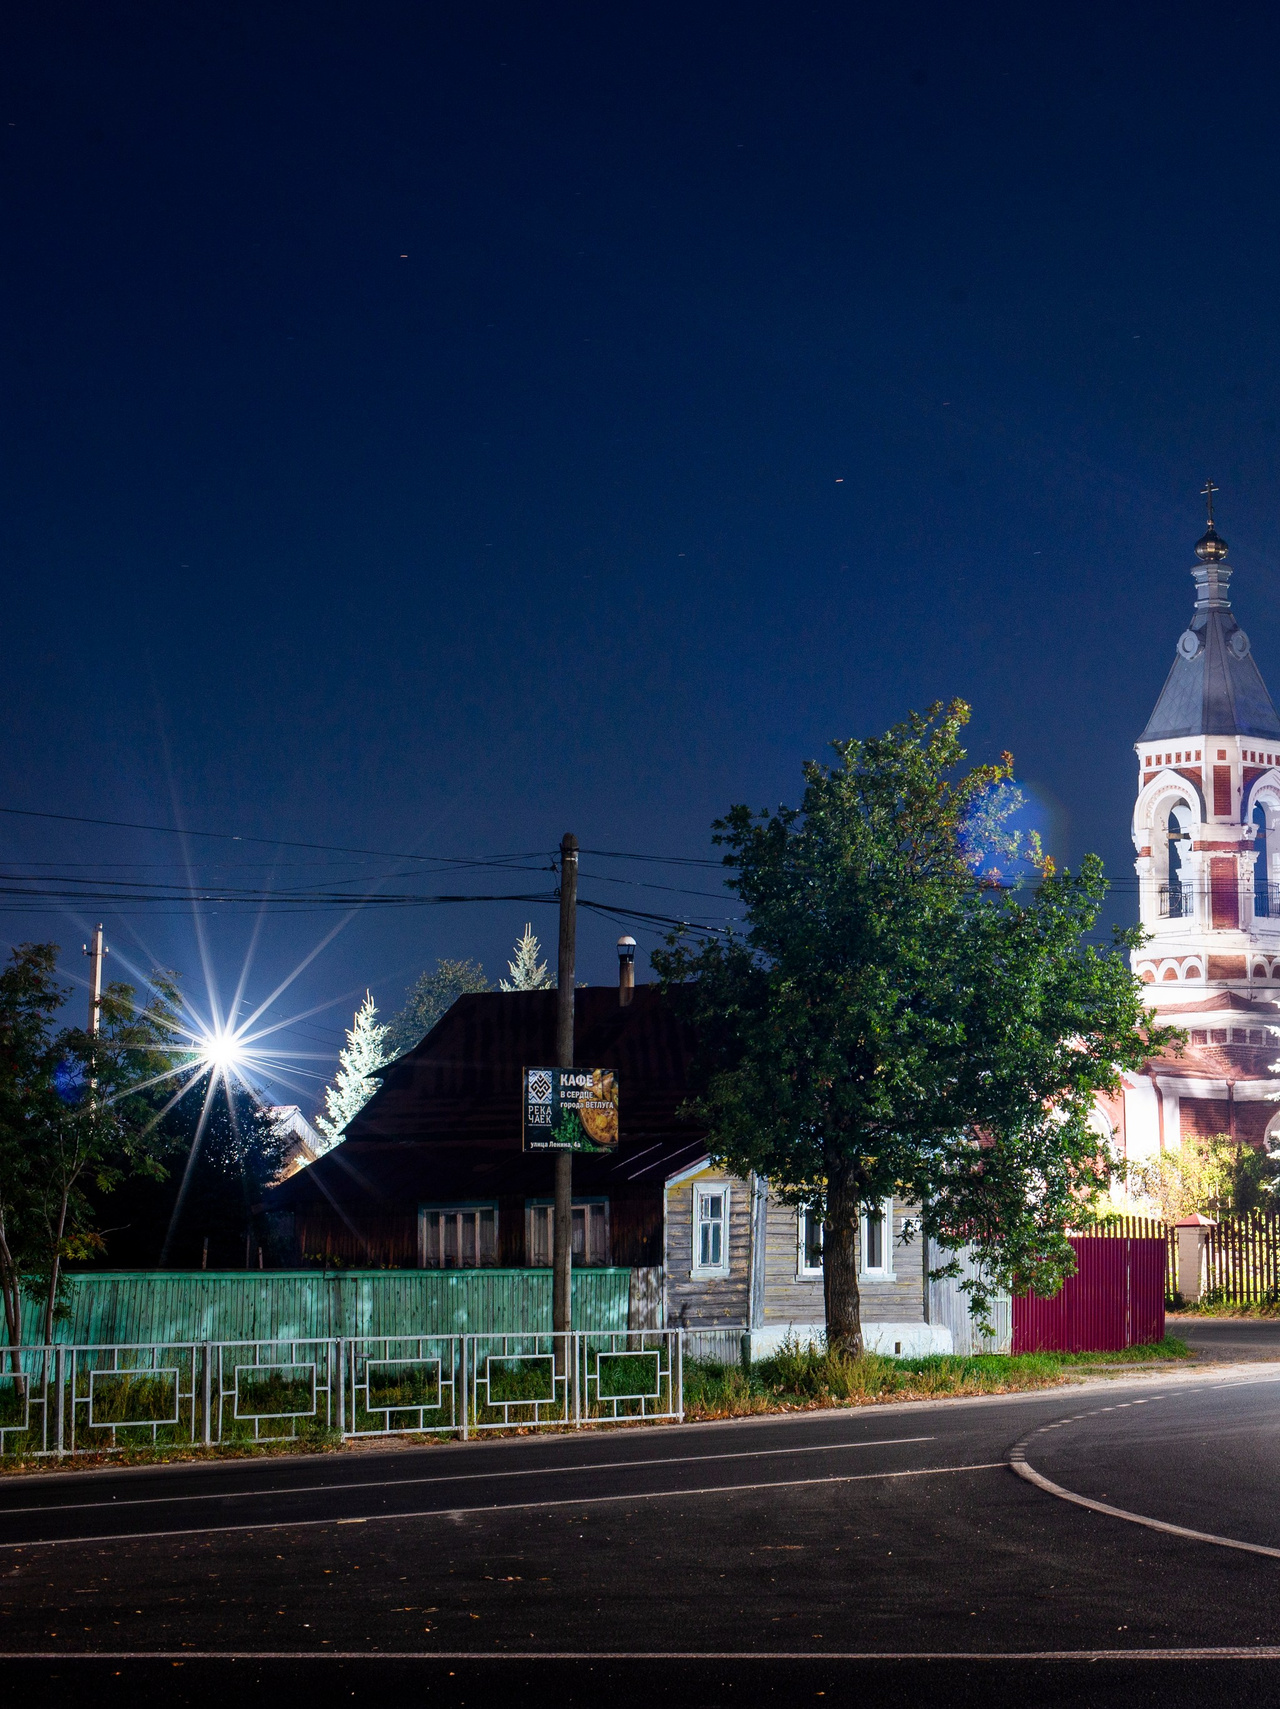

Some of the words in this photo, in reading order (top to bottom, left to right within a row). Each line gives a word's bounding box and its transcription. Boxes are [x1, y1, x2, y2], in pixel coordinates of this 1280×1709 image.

[560, 1074, 594, 1087] КАФЕ
[566, 1091, 594, 1099] СЕРДЦЕ
[528, 1105, 553, 1115] РЕКА
[585, 1101, 614, 1109] ВЕТЛУГА
[528, 1114, 552, 1124] ЧАЕК
